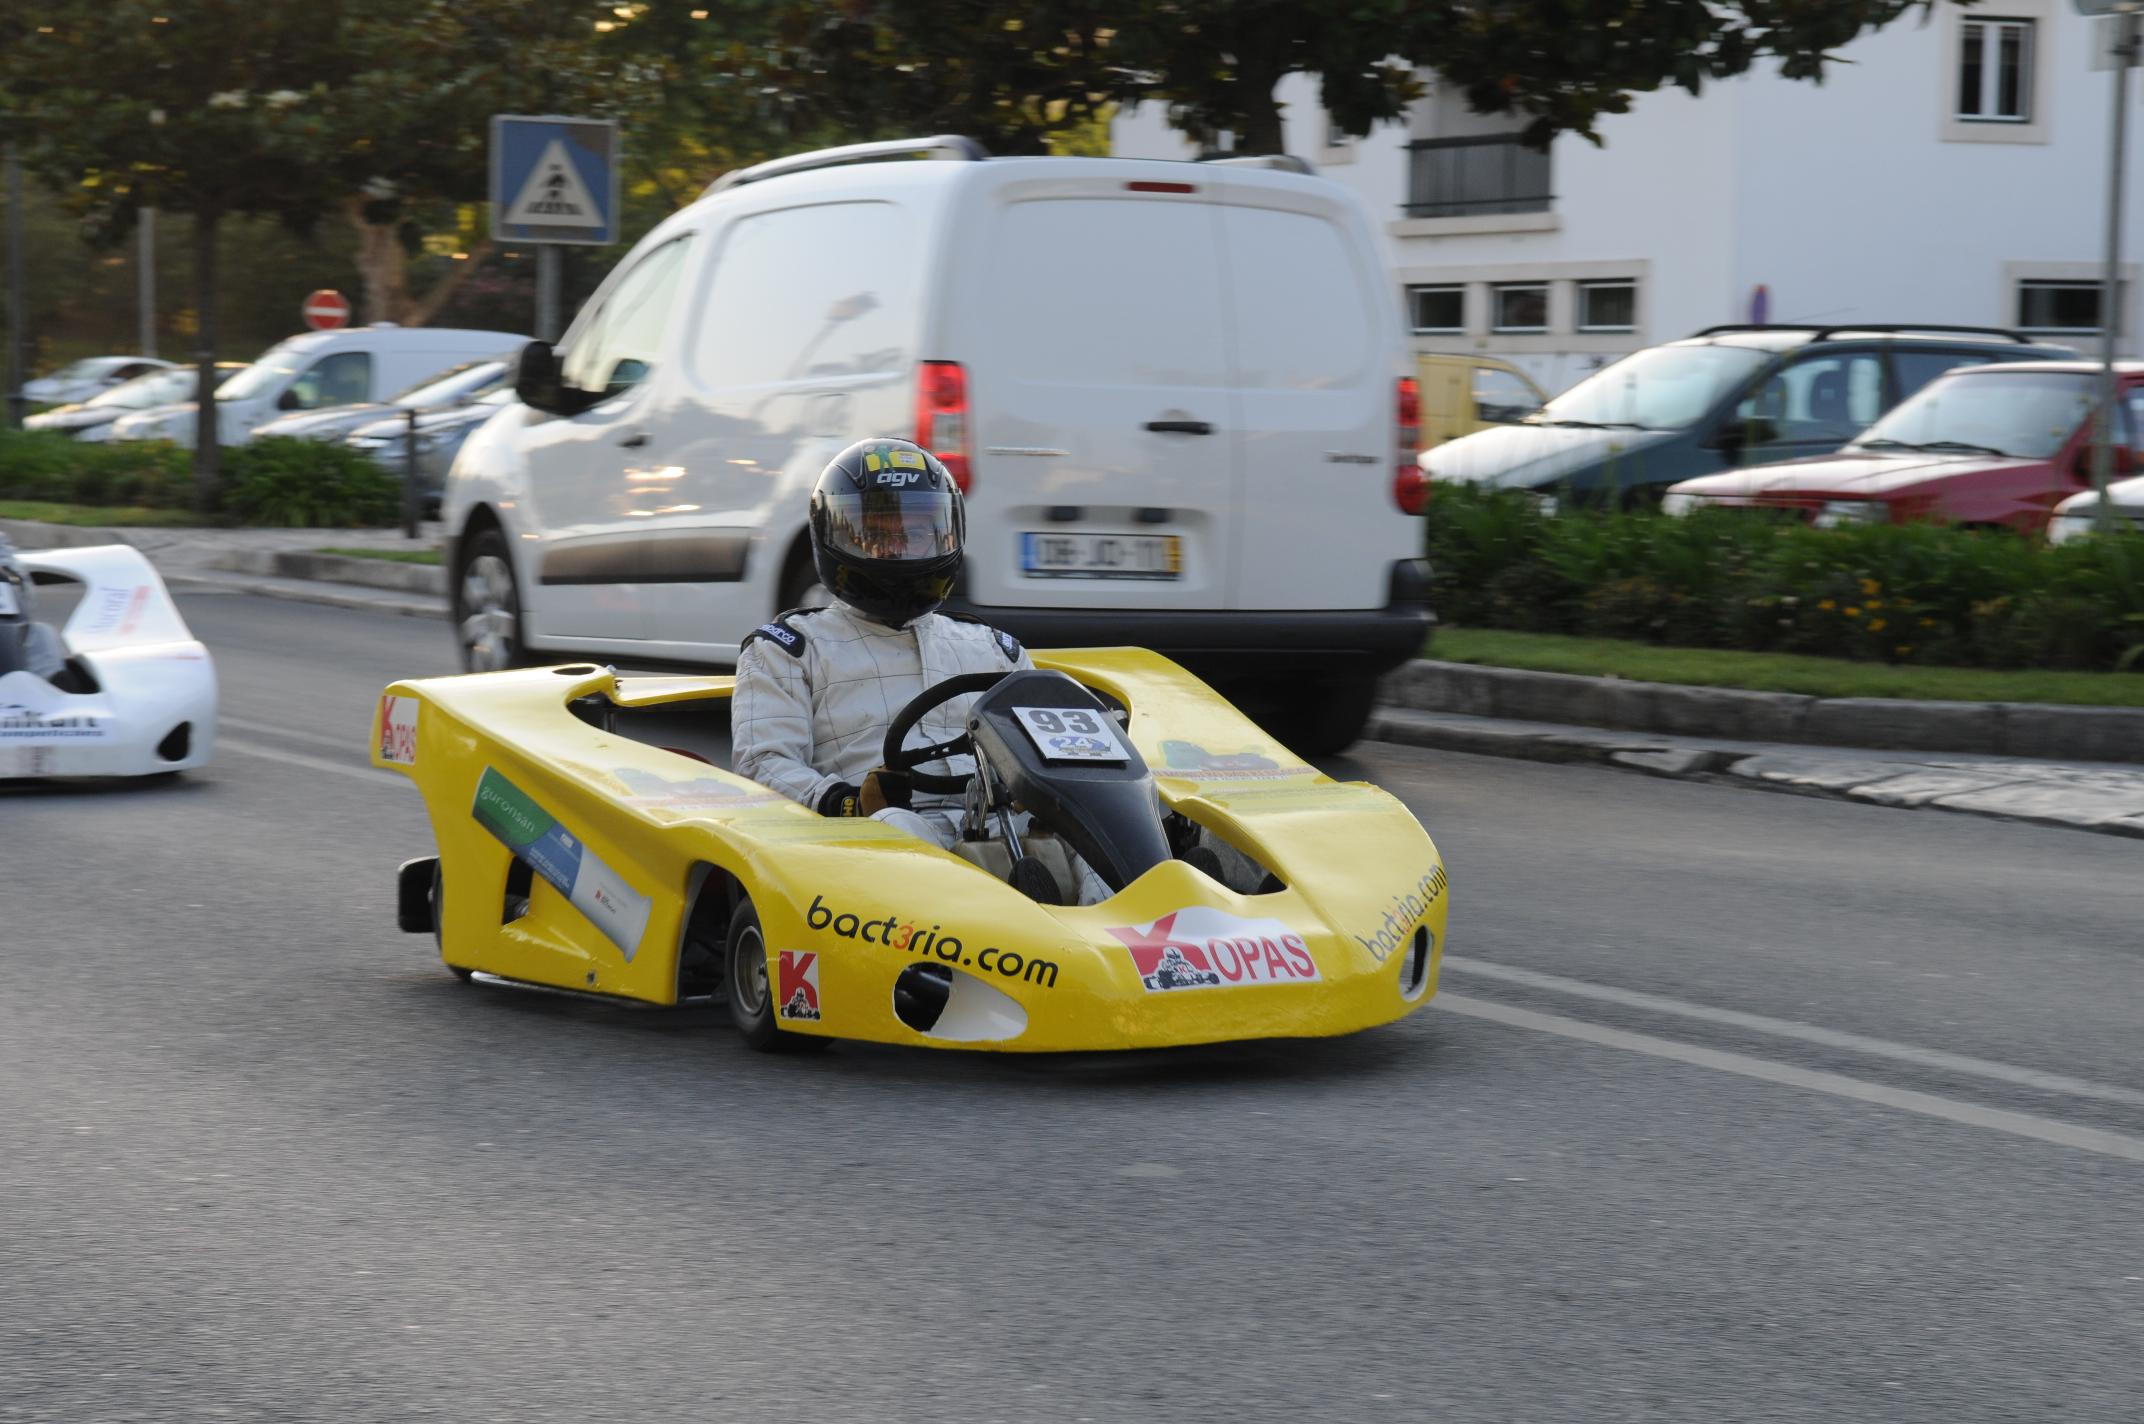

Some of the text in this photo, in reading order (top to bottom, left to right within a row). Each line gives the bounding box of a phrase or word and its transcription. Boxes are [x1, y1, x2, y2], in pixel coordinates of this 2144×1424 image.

[876, 472, 920, 487] agv
[1028, 710, 1100, 734] 93
[479, 784, 536, 833] guronsan
[1104, 910, 1316, 984] KOPAS
[779, 950, 819, 1009] K
